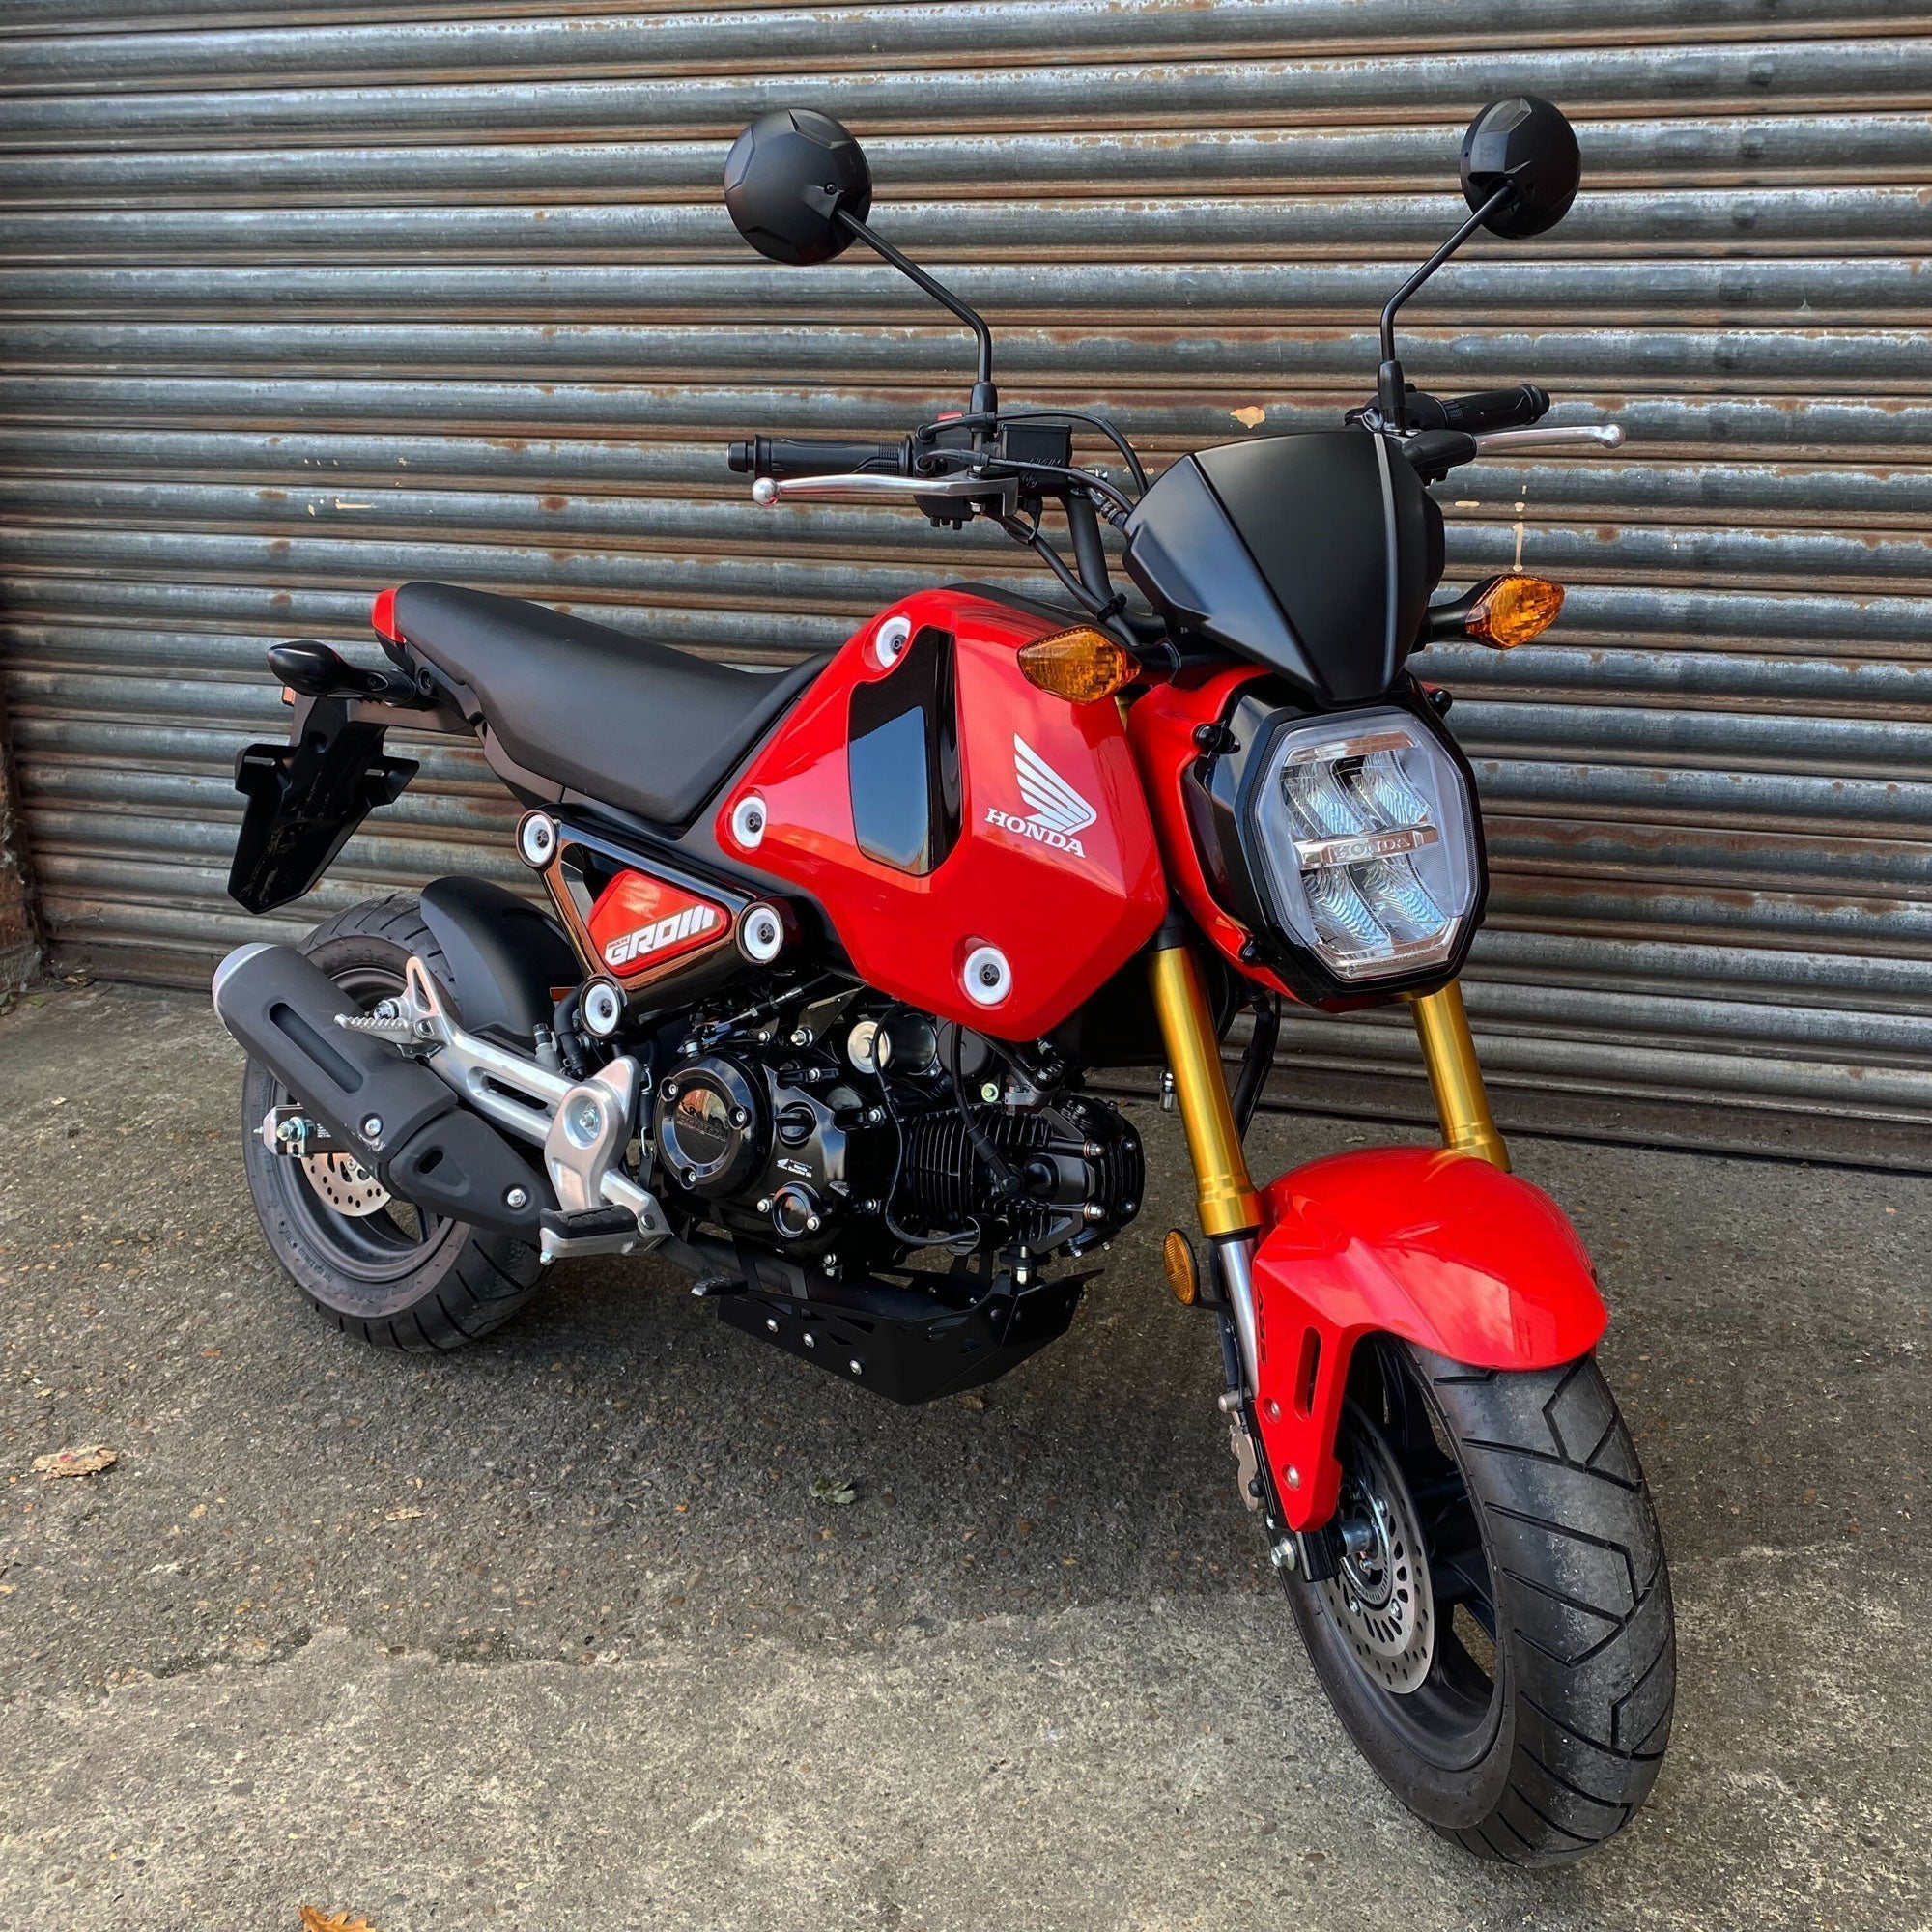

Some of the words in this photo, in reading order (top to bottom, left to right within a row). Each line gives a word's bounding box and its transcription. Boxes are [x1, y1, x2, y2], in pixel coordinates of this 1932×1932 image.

[985, 808, 1086, 858] HONDA
[1334, 836, 1411, 859] HONDA
[605, 905, 715, 966] GROM
